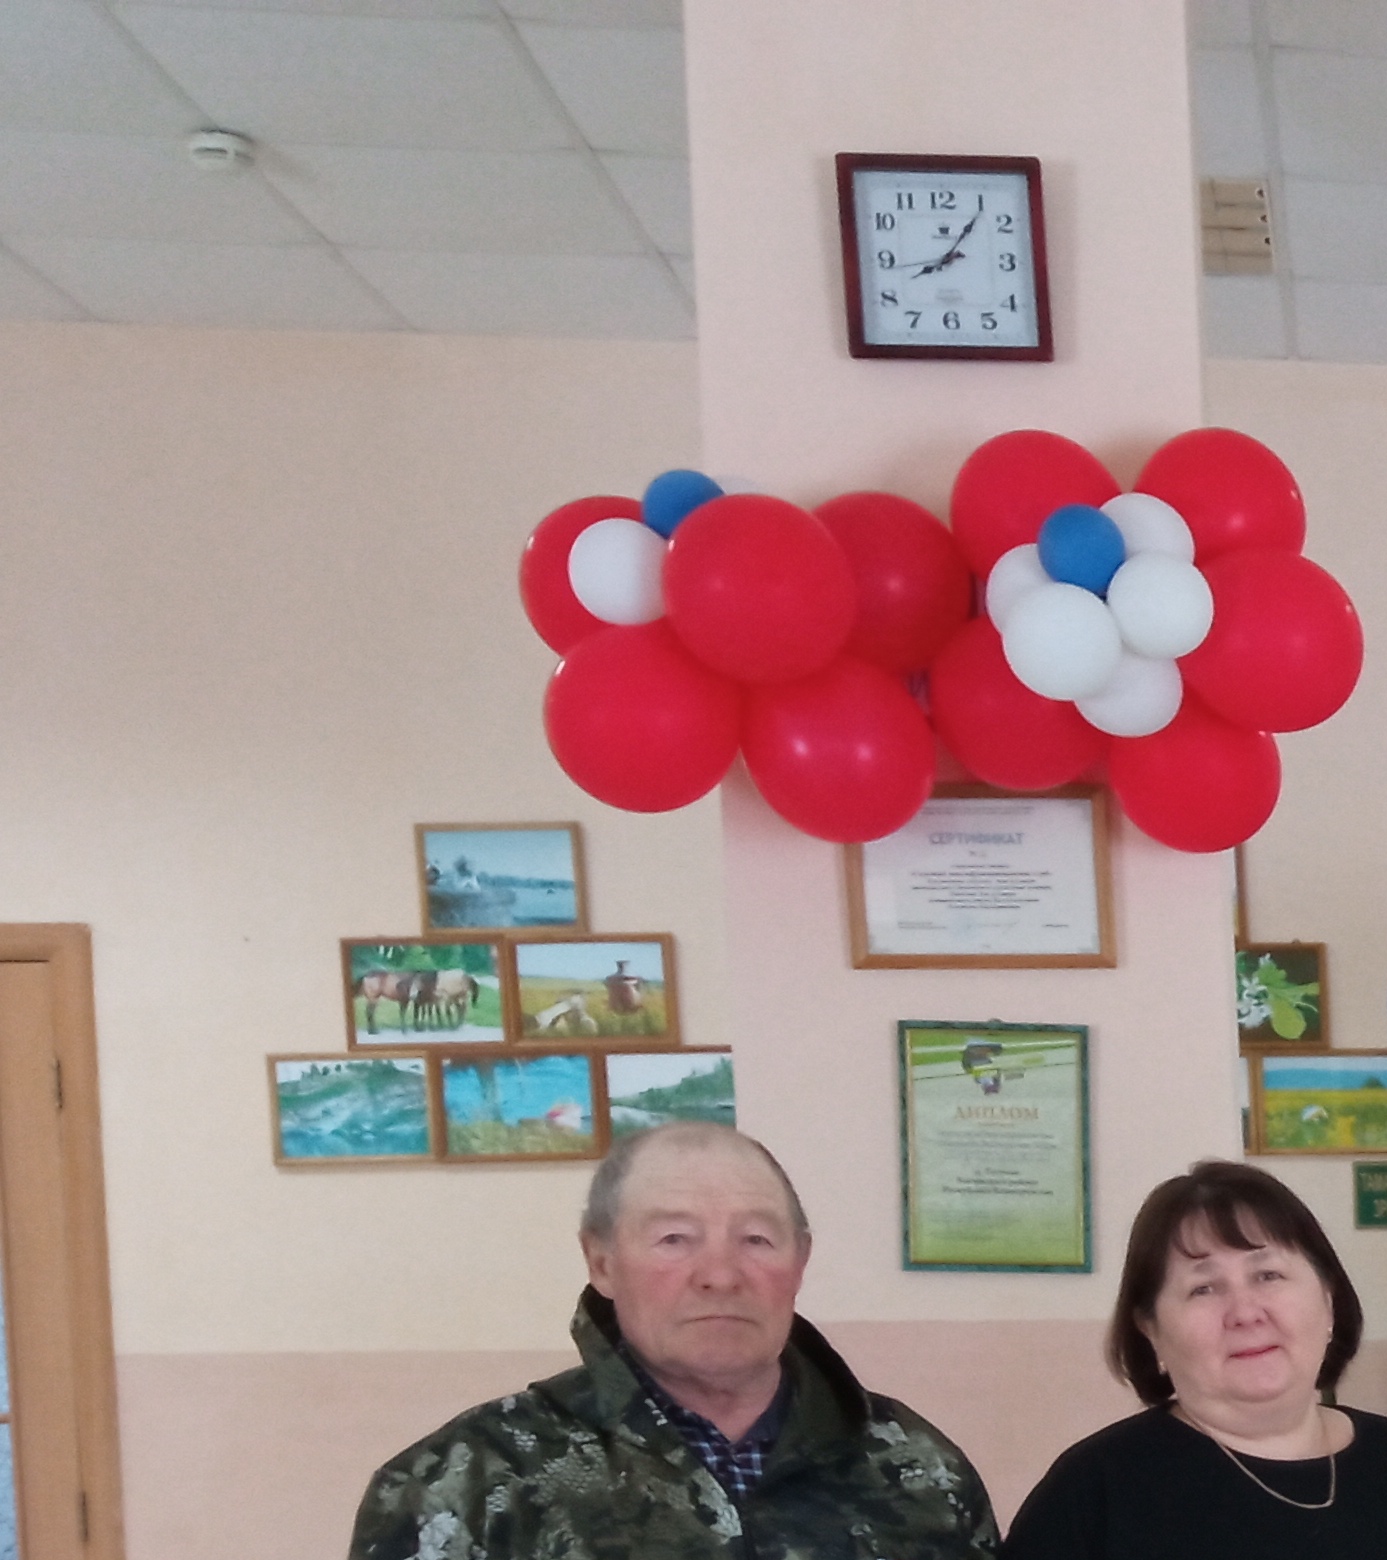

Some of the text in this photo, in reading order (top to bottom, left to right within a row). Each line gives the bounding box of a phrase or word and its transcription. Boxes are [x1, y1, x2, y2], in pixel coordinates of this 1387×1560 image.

[896, 192, 915, 211] 11
[929, 190, 957, 210] 12
[976, 194, 985, 212] 1
[875, 212, 896, 231] 10
[995, 213, 1014, 233] 2
[877, 250, 896, 269] 9
[998, 252, 1017, 272] 3
[880, 290, 899, 308] 8
[1000, 293, 1018, 312] 4
[904, 310, 922, 329] 7
[942, 311, 961, 330] 6
[980, 312, 998, 330] 5
